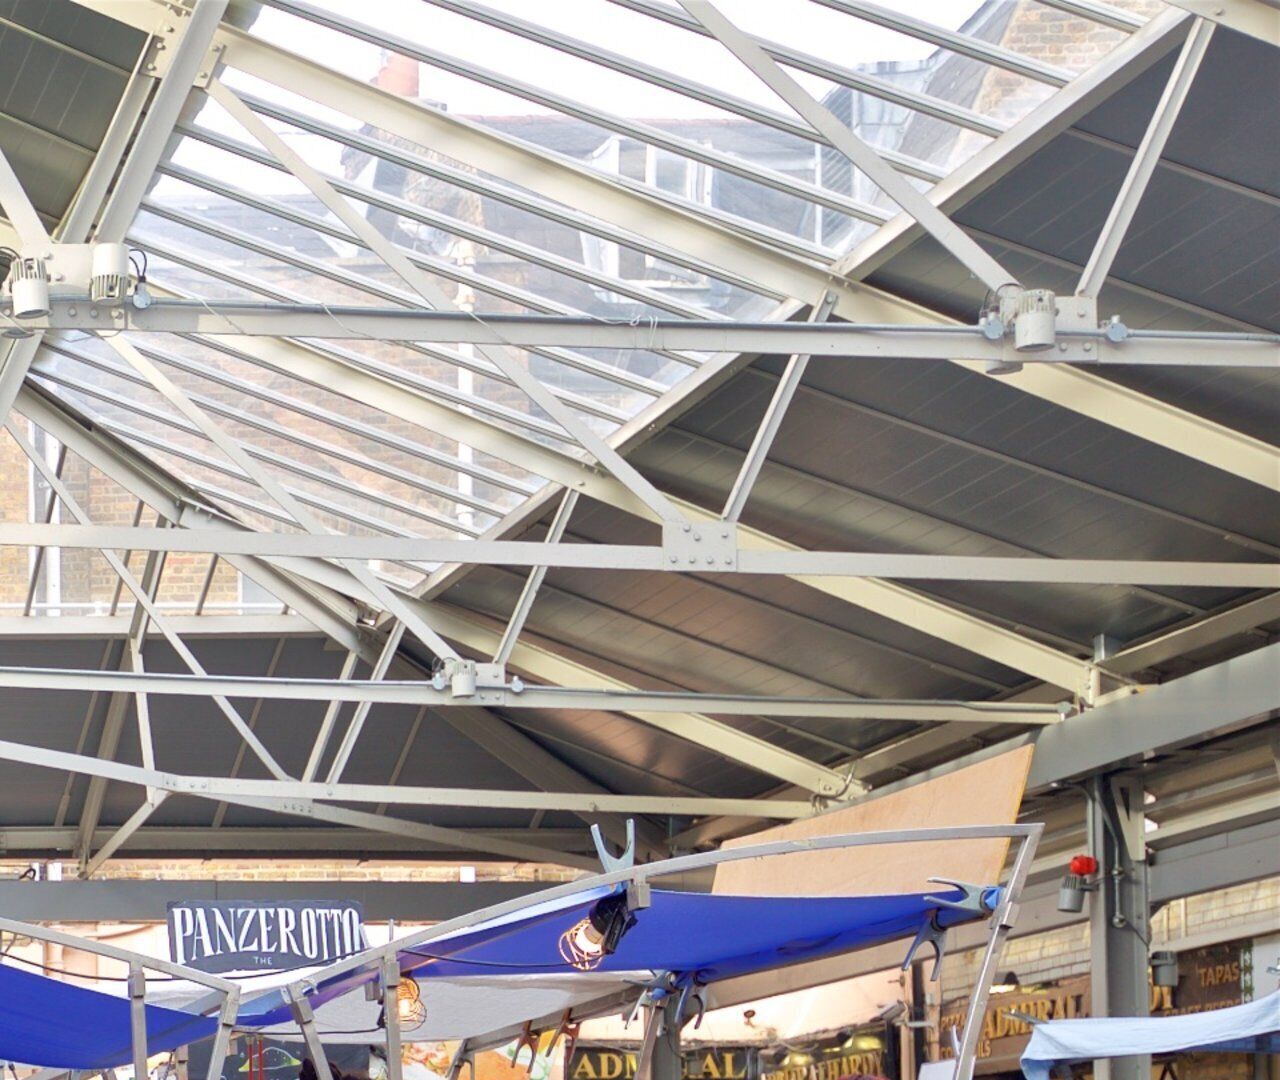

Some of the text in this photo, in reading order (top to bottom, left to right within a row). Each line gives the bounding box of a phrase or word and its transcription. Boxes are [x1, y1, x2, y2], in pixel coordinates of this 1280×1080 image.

[172, 906, 362, 965] PANZEROTTO
[252, 956, 273, 966] THE
[1198, 962, 1240, 987] TAPAS
[941, 1012, 967, 1032] PIZZ
